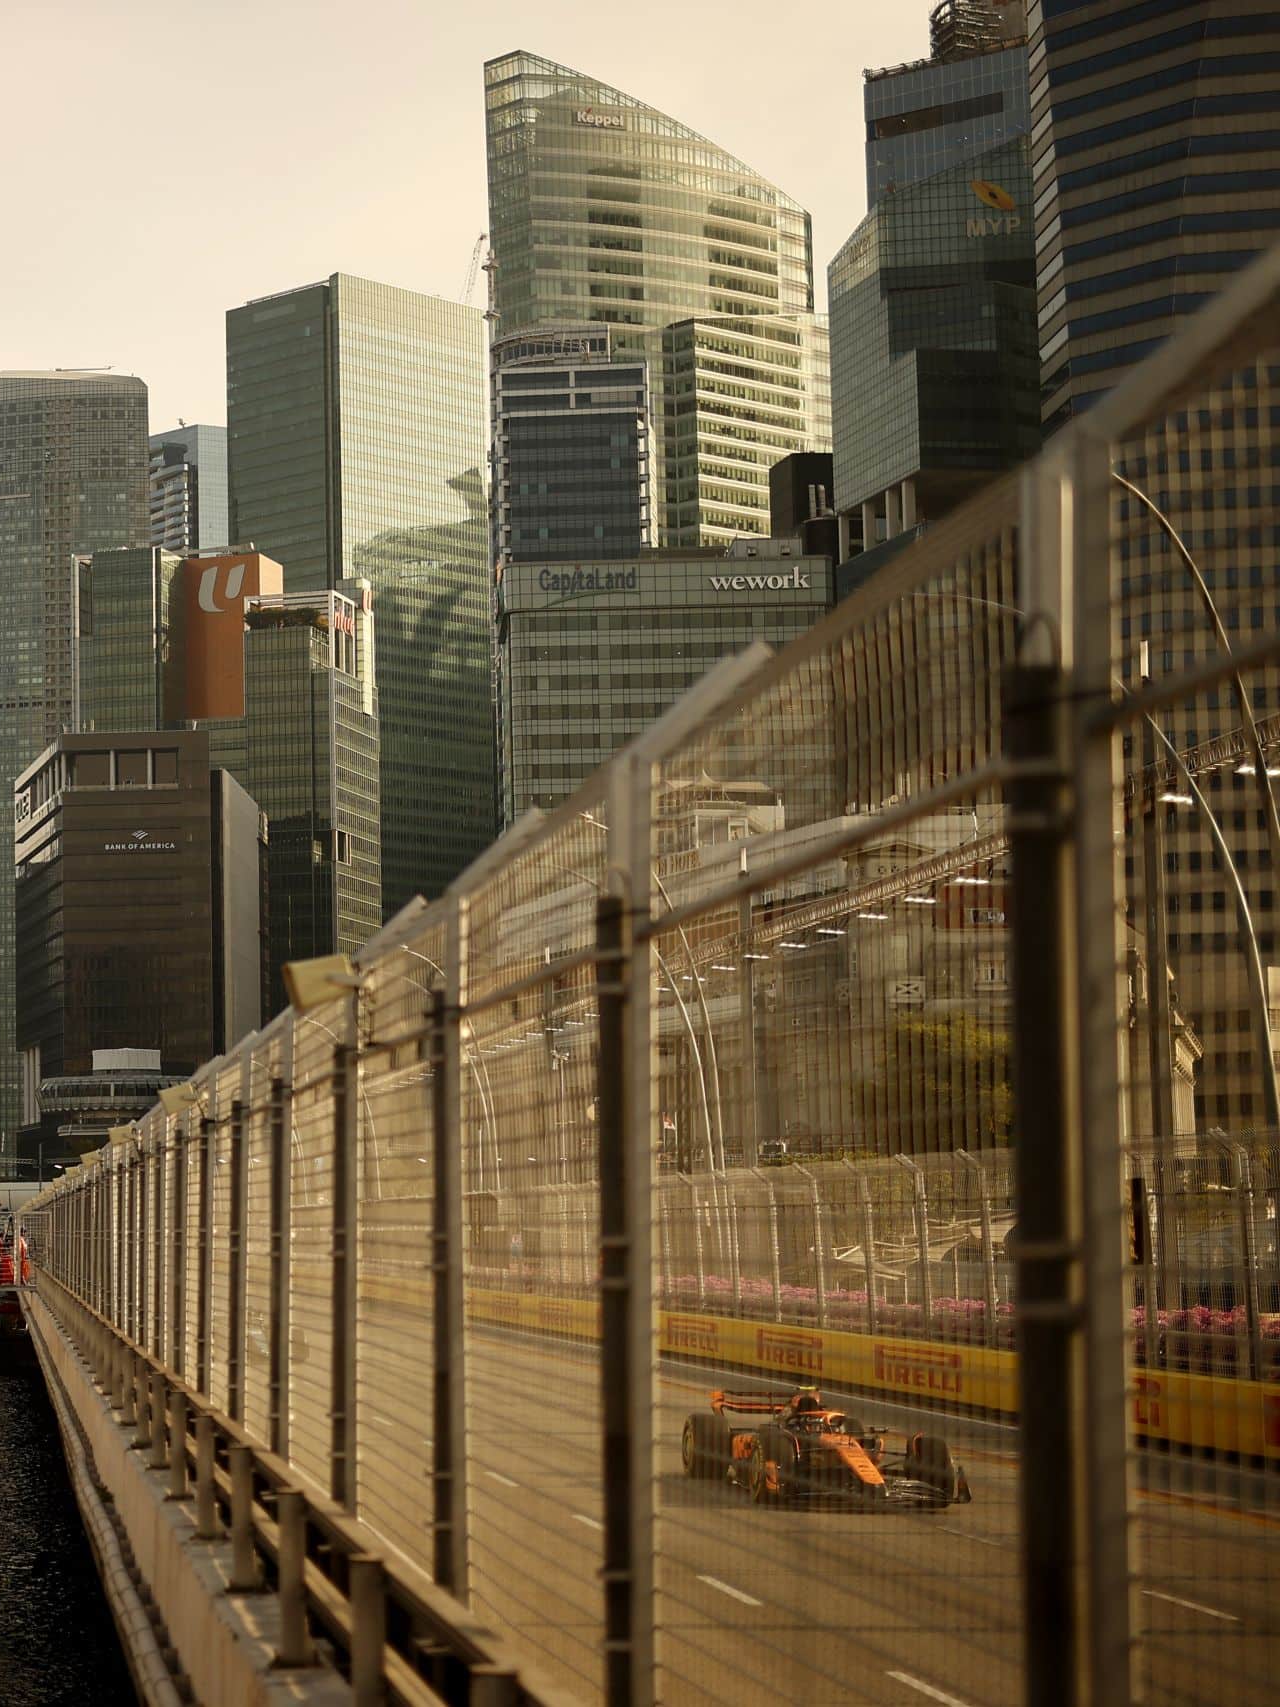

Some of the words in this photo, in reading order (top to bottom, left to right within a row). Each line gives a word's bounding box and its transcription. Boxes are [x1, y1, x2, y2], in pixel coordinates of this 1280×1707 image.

[577, 111, 624, 127] Keppel
[967, 217, 1020, 237] MYP
[539, 565, 637, 597] CapitaLand
[710, 566, 810, 590] wework
[667, 1317, 719, 1352] PIRELLI
[757, 1328, 823, 1371] PIRELLI
[874, 1344, 961, 1393] PIRELLI
